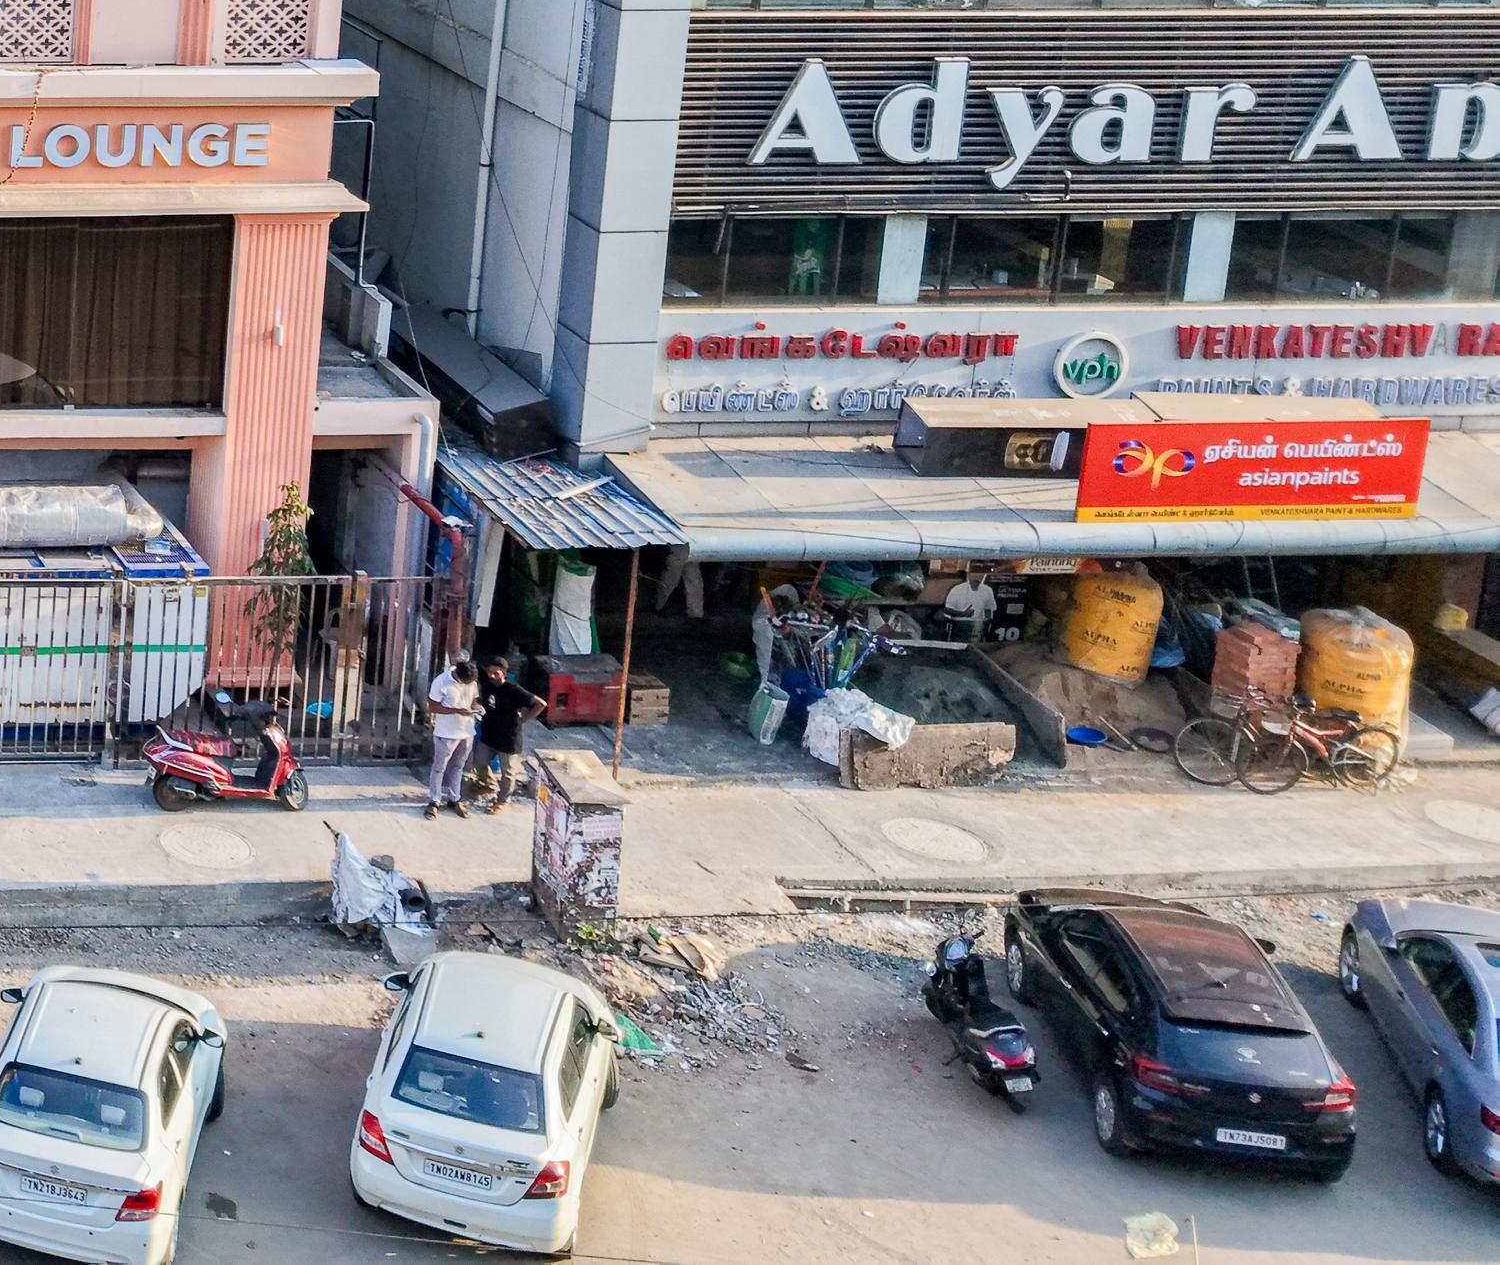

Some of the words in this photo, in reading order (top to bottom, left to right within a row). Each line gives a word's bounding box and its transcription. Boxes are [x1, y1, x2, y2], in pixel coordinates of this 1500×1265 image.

[747, 57, 1258, 189] Adyar
[10, 123, 270, 166] LOUNGE
[1063, 352, 1122, 383] vph
[1202, 435, 1278, 465] ஏசியன்
[1284, 433, 1403, 458] பெயிண்ட்ஸ்
[1238, 468, 1360, 492] asianpaints
